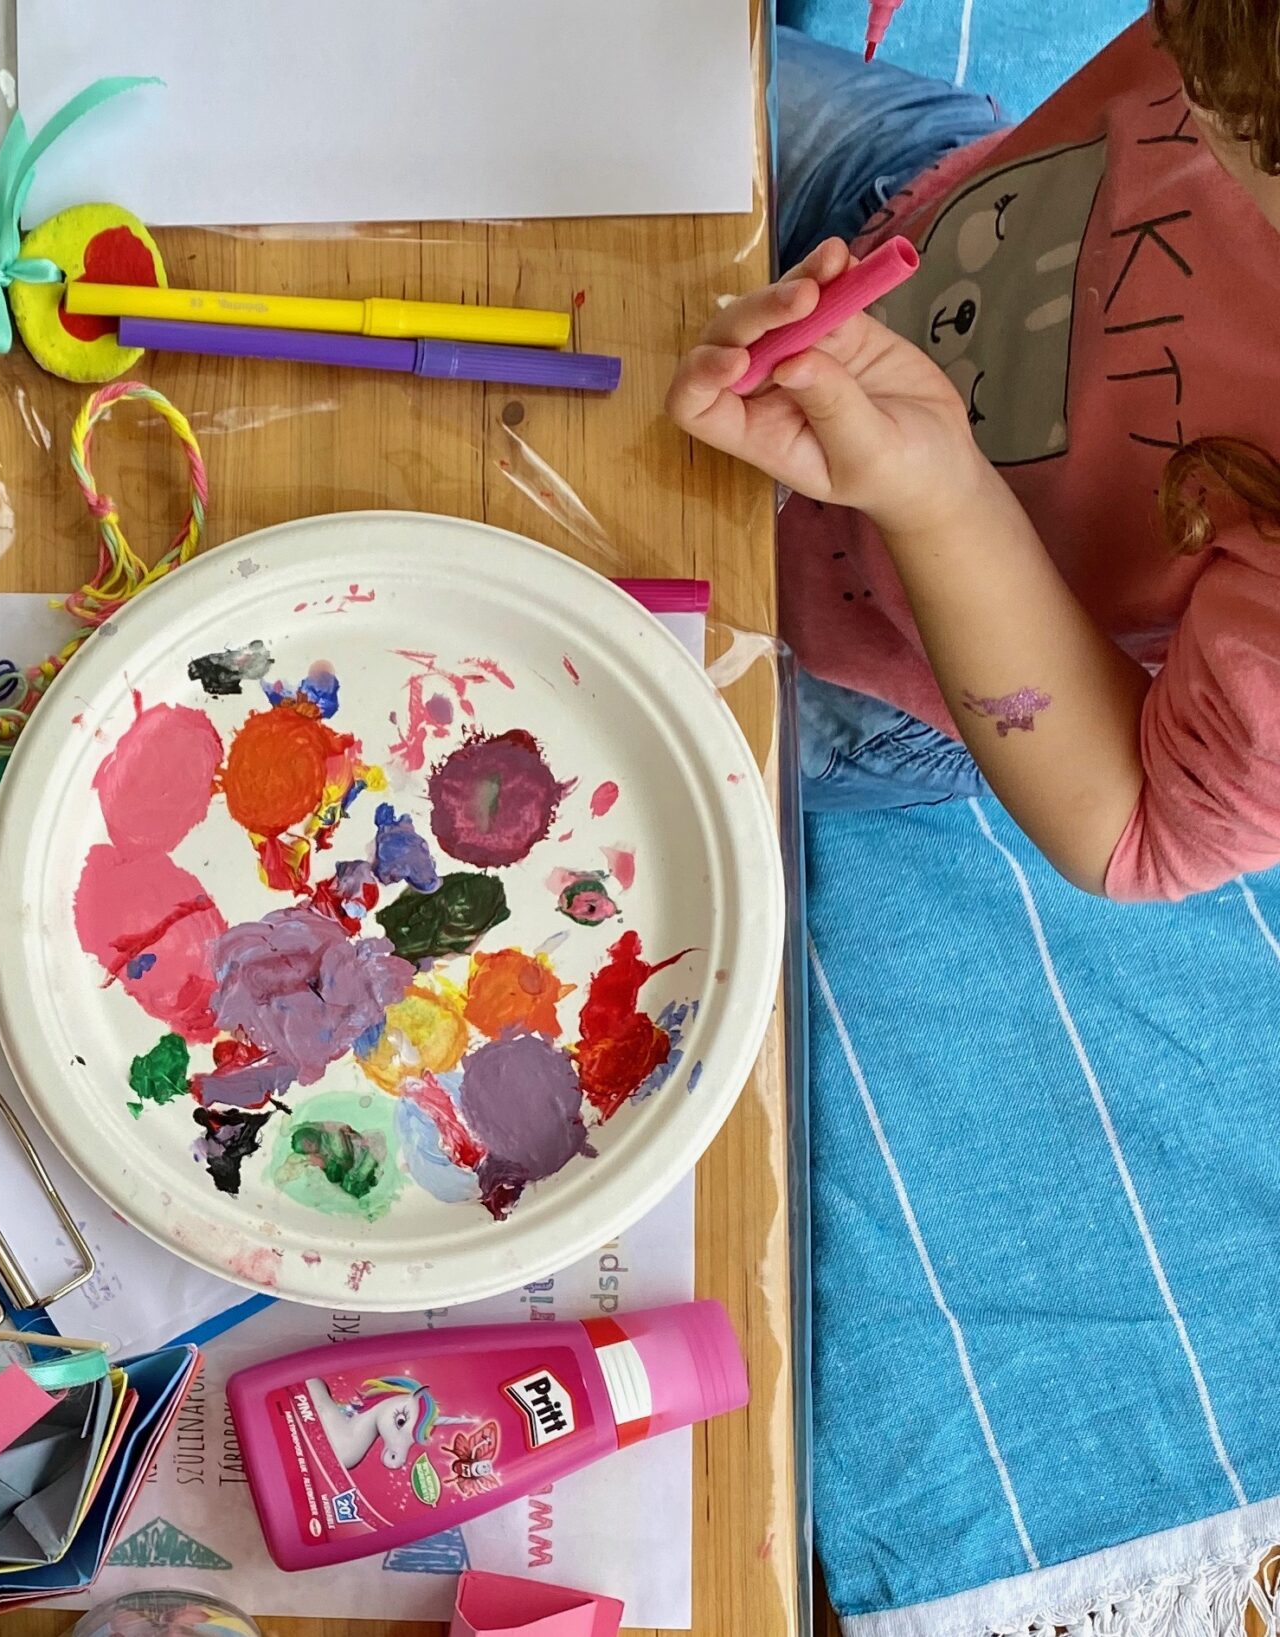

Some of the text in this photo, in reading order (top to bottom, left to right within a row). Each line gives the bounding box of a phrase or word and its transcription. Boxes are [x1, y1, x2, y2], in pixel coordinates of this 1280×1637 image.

[1104, 209, 1194, 450] KITT
[294, 1394, 315, 1422] PINK
[524, 1376, 568, 1436] Pritt
